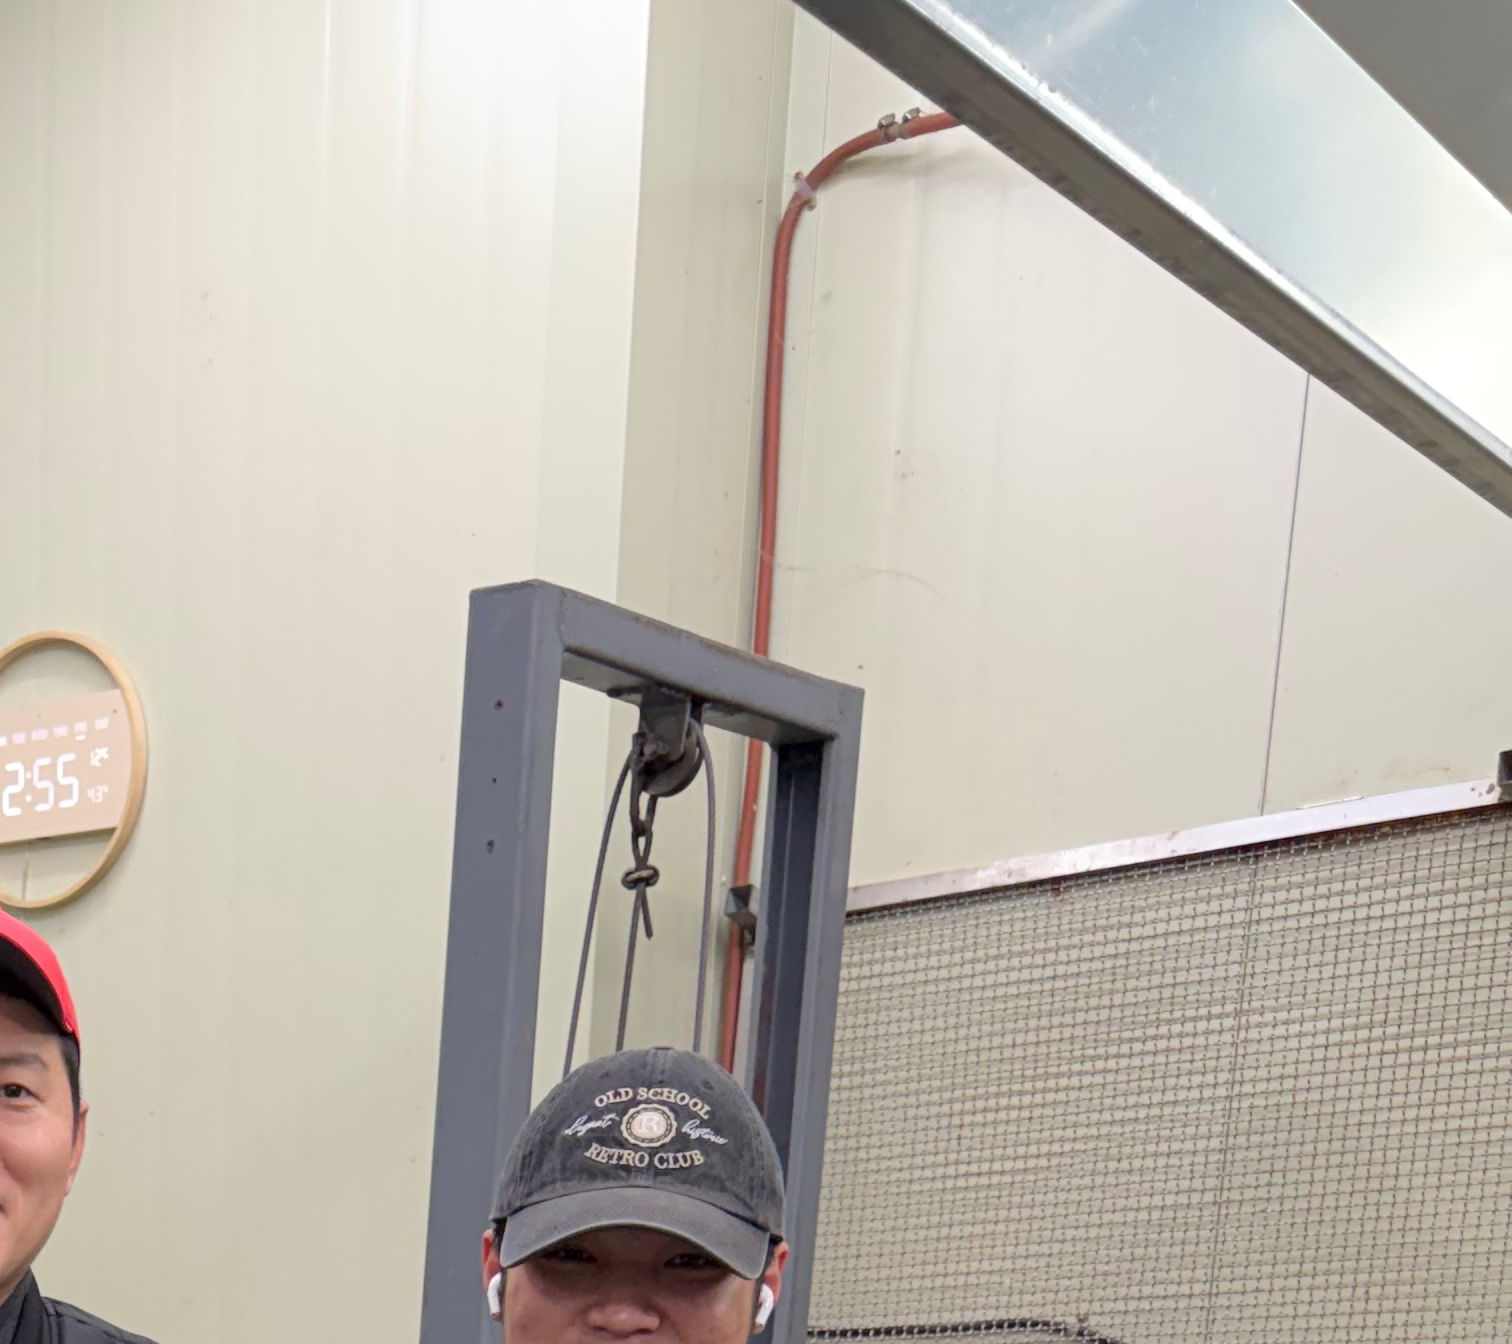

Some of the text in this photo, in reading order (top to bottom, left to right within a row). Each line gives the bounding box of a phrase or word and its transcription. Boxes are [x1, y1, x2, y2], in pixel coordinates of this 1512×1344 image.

[1, 752, 80, 817] 2:55
[594, 1087, 712, 1120] OLD SCHOOL
[583, 1142, 704, 1169] RETRO CLUB
